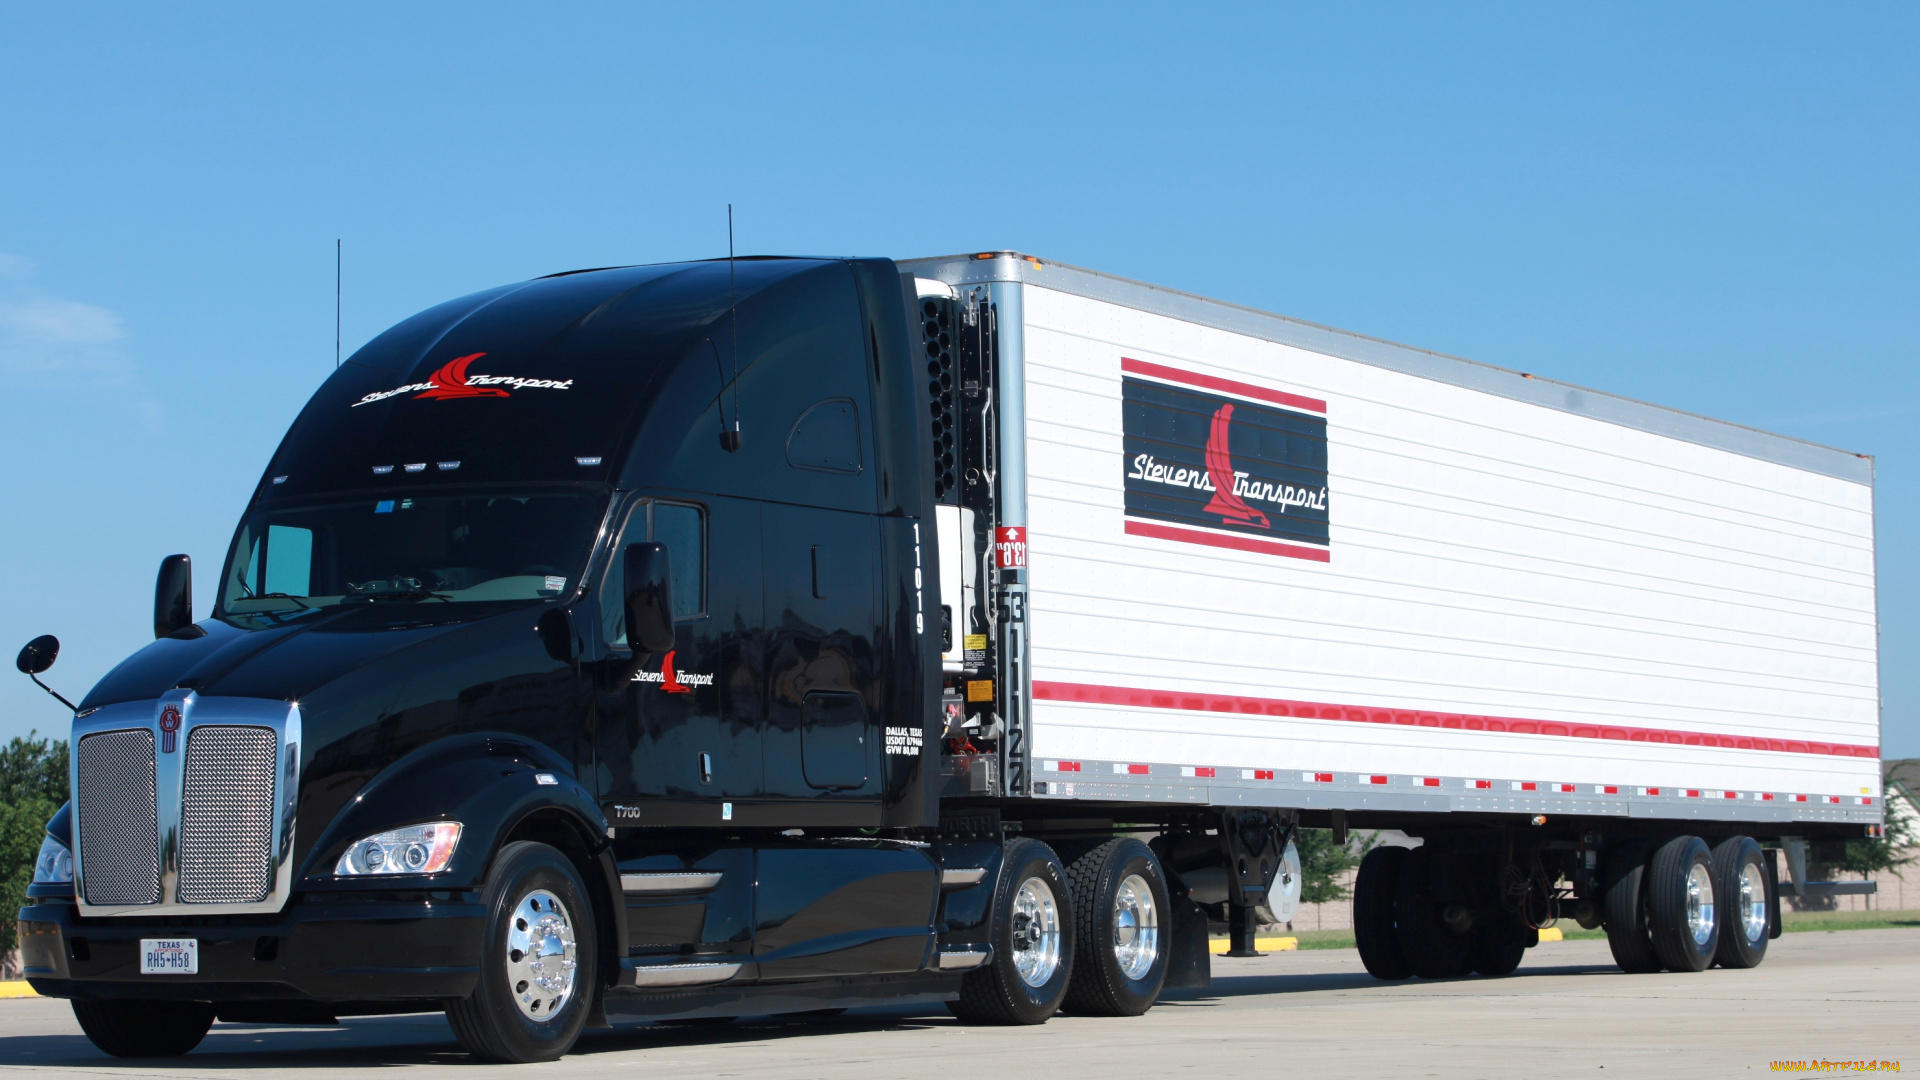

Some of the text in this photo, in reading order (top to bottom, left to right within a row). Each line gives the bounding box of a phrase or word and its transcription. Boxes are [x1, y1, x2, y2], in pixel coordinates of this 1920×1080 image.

[351, 375, 573, 407] Stevens Transport
[1128, 454, 1326, 513] Stevens Transport
[630, 669, 714, 688] Stevens Transport
[886, 736, 906, 746] USDOT
[886, 745, 902, 755] GVW
[614, 805, 640, 818] T700
[157, 941, 181, 949] TEXAS
